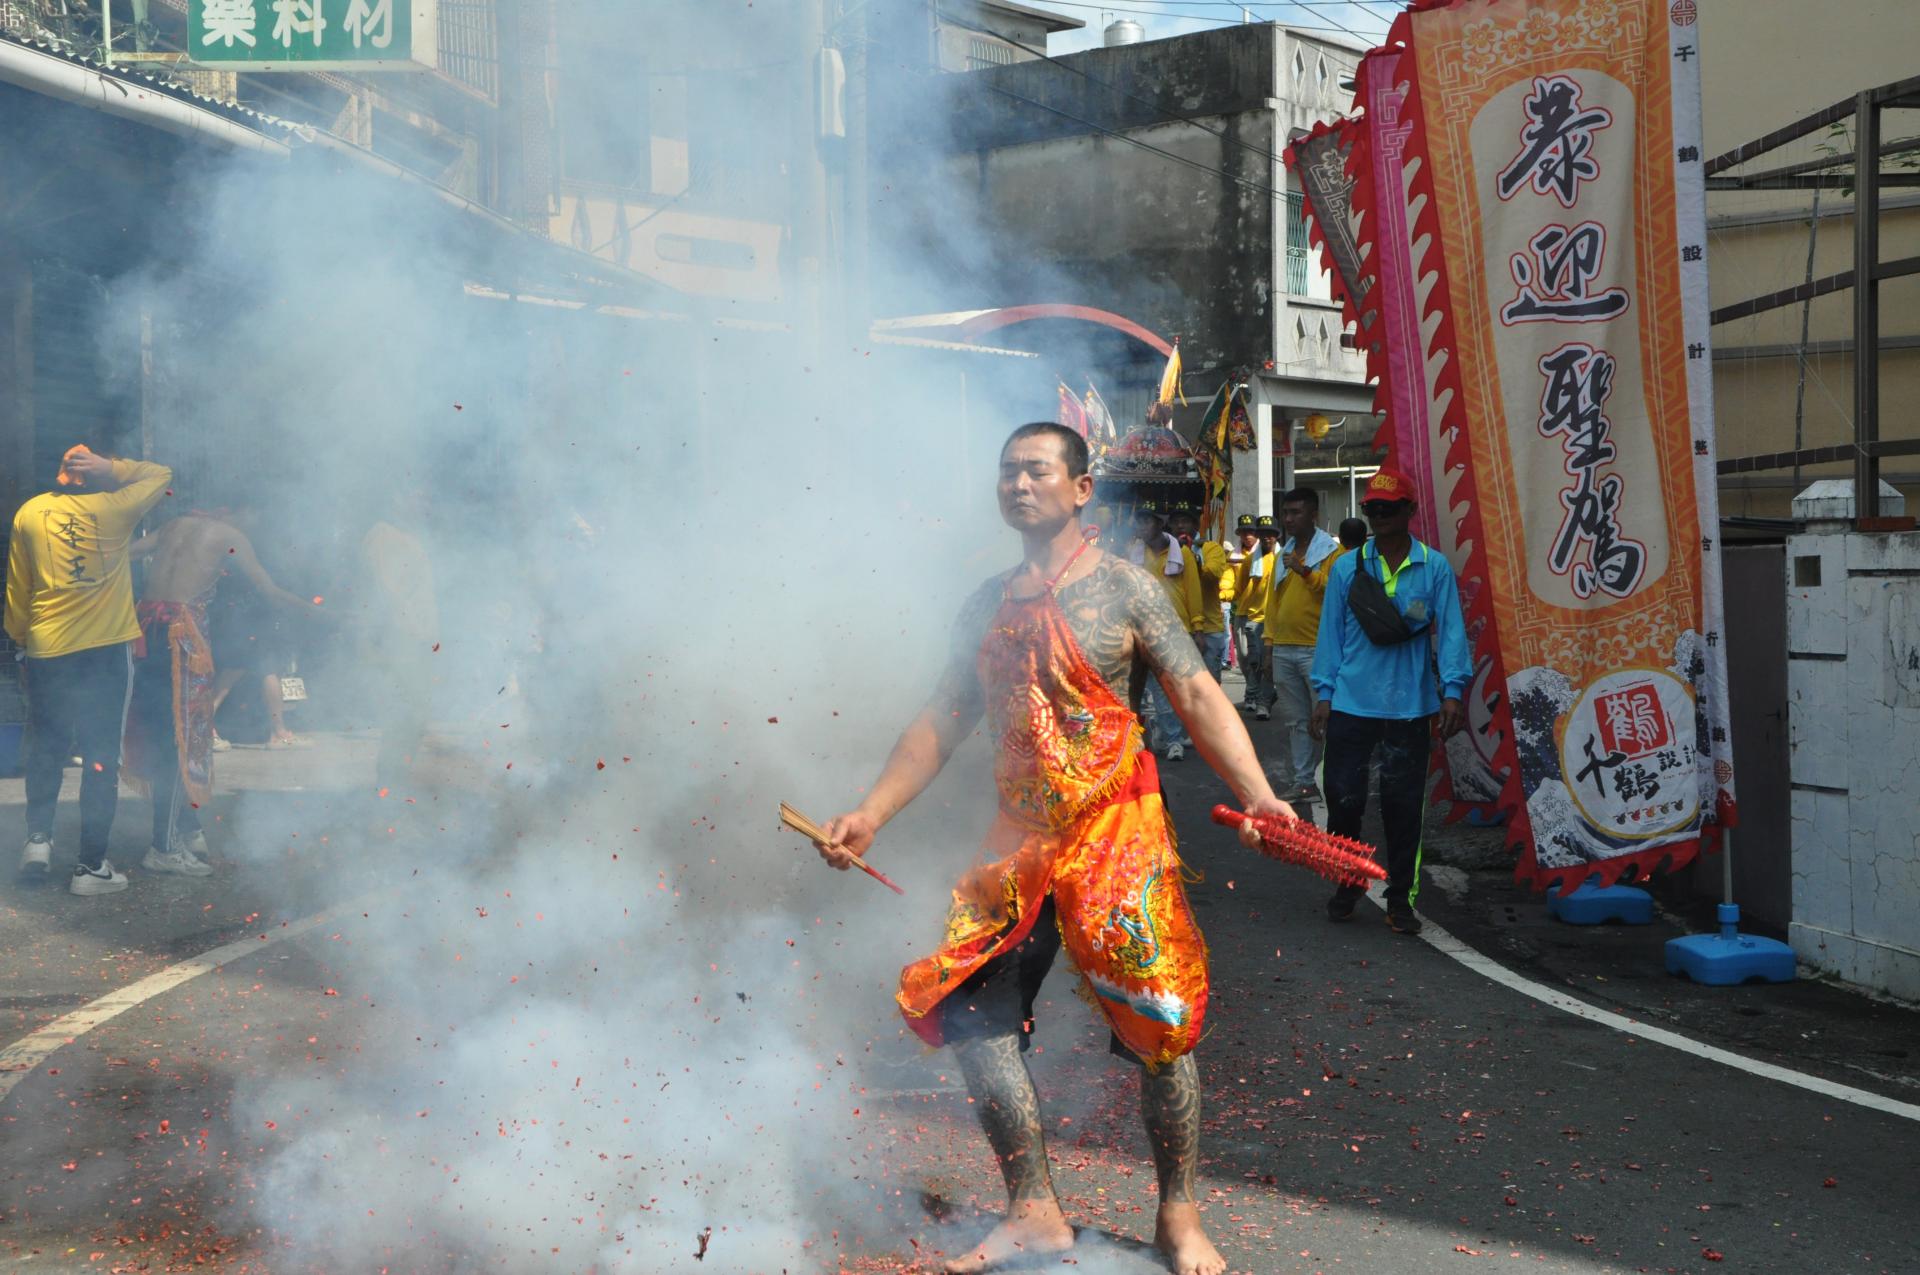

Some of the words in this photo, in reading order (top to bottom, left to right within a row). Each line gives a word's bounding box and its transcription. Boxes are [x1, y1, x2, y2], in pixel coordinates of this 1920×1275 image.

[1500, 79, 1644, 597] 恭迎聖駕
[55, 517, 97, 585] 李王
